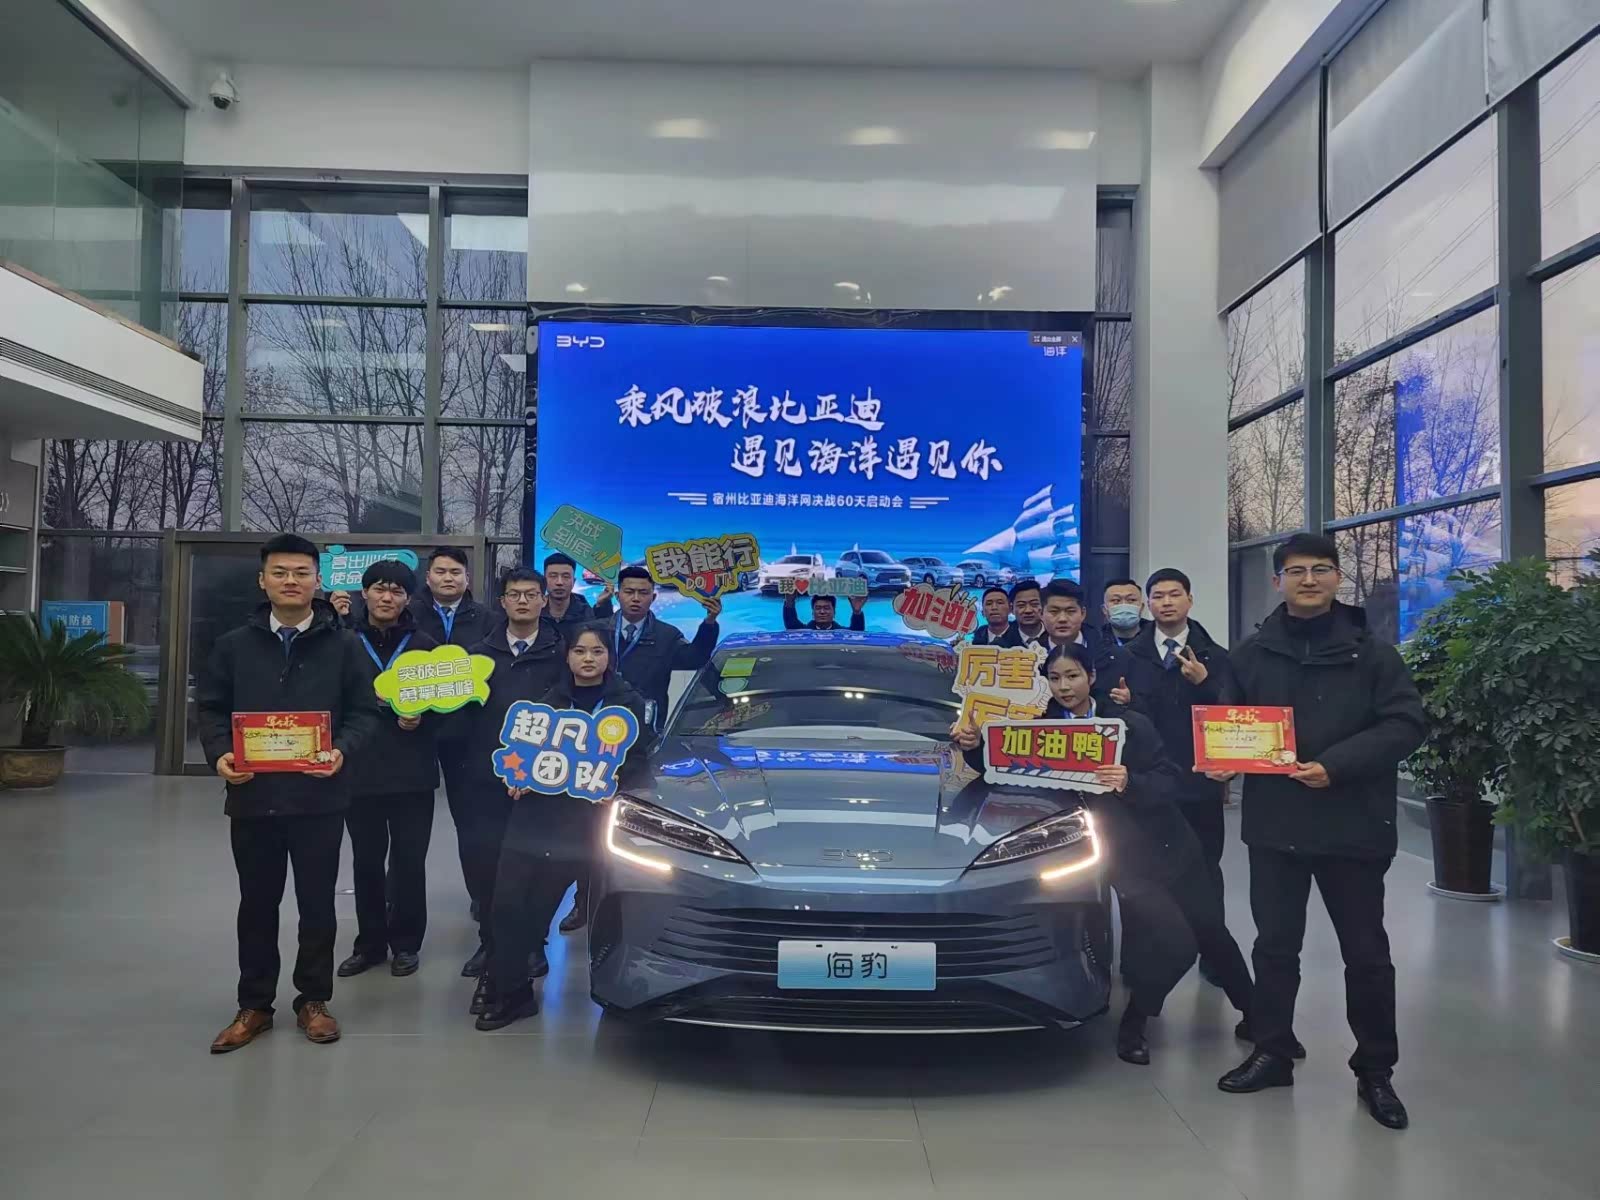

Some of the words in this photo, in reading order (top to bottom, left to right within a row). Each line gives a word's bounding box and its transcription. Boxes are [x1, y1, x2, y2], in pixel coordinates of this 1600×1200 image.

[556, 335, 605, 348] BYD
[615, 383, 885, 431] 乘风破浪比亚迪
[730, 434, 1004, 481] 遇见海洋遇见你
[712, 492, 904, 509] 宿州比亚迪海洋网决战60天启动会
[562, 510, 605, 541] 决战
[652, 538, 757, 579] 我能行
[686, 576, 706, 590] DO
[808, 578, 868, 595] 比亚迪
[398, 658, 472, 682] 突破自己
[959, 648, 1038, 690] 厉害
[399, 680, 474, 704] 勇攀高峰
[509, 709, 588, 752] 超凡
[1001, 726, 1105, 763] 加油鸭
[532, 750, 609, 792] 团队
[821, 848, 894, 863] BYD
[826, 951, 888, 979] 海豹
